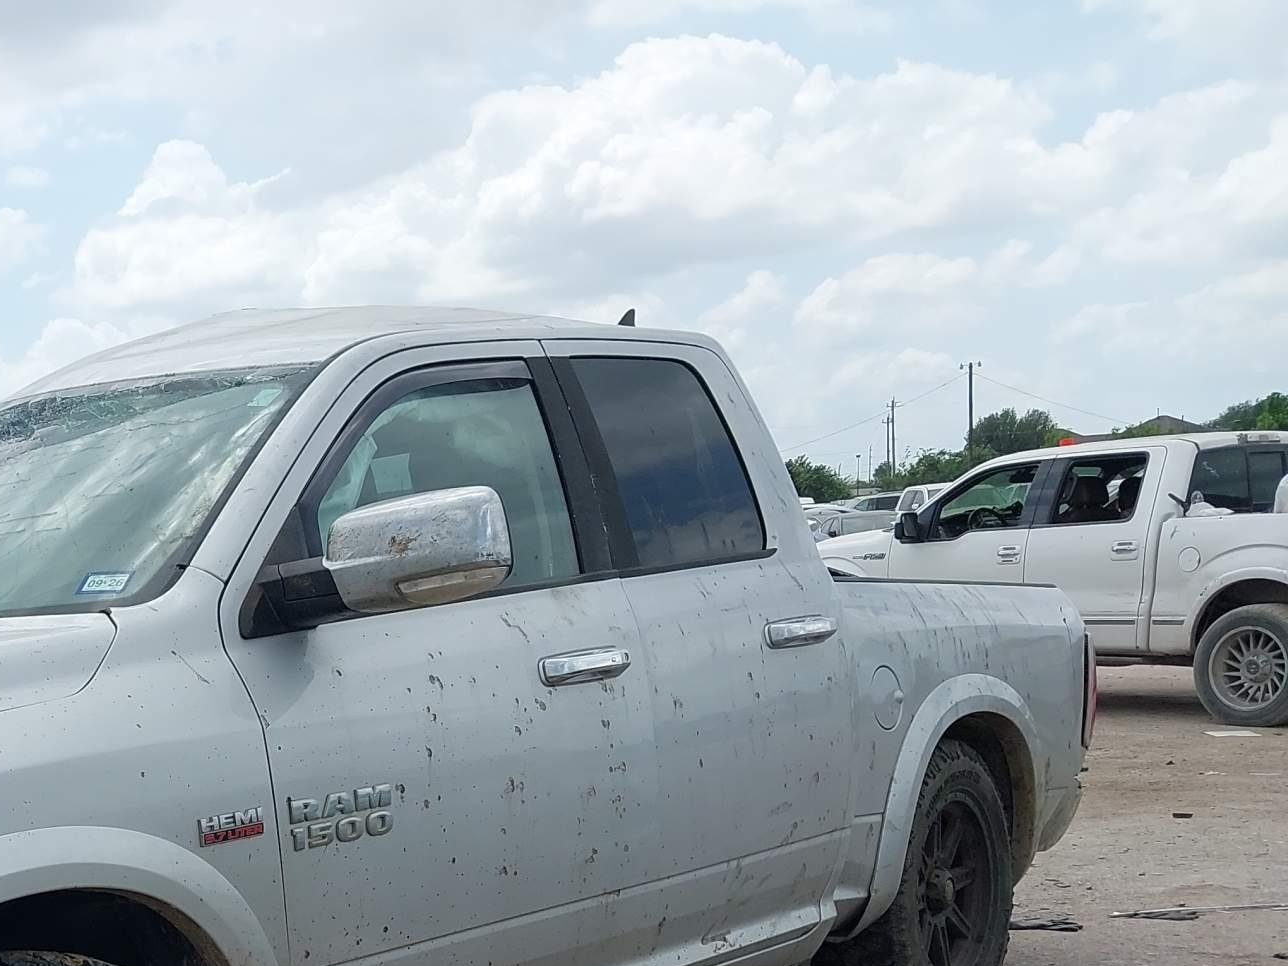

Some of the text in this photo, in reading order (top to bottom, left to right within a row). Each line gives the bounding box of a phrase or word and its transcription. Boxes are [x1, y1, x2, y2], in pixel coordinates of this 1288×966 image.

[198, 806, 263, 833] HEMI
[287, 782, 393, 825] RAM
[290, 810, 394, 852] 1500
